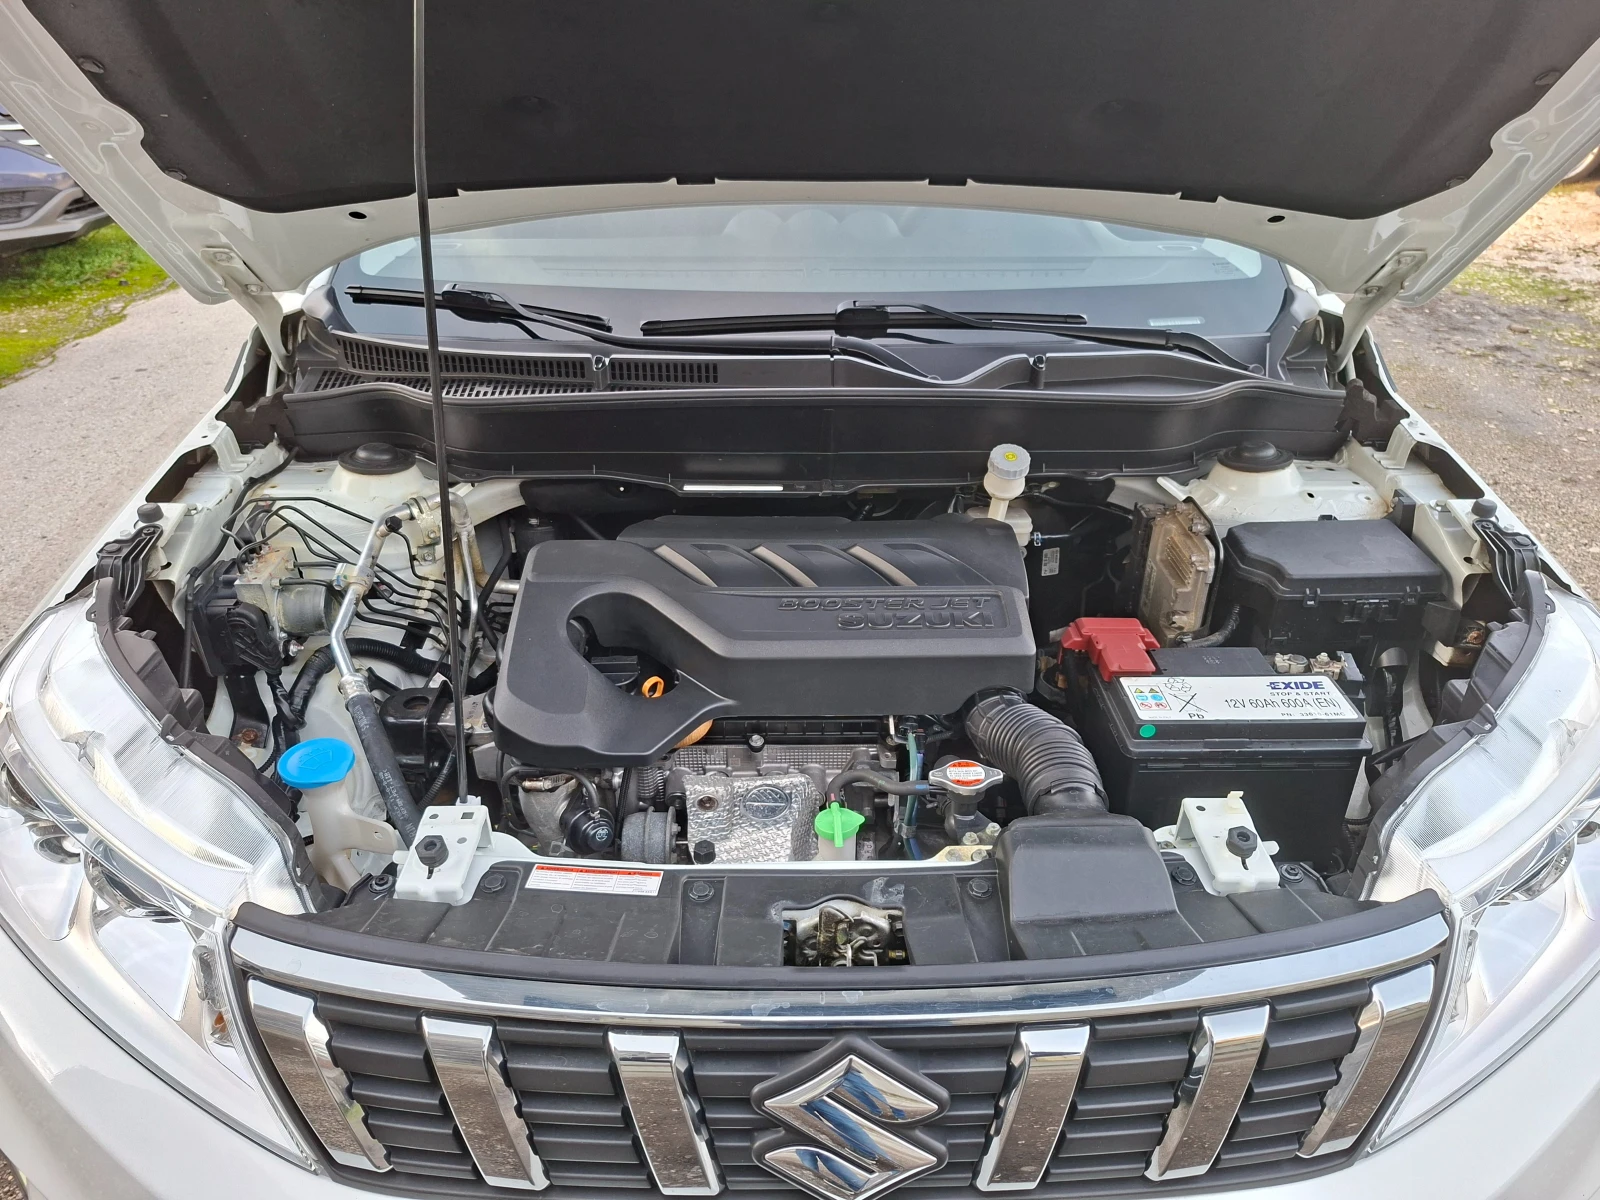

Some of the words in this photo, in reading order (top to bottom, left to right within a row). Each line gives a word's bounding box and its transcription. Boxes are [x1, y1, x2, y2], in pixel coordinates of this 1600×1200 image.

[777, 597, 925, 611] BOOSTER
[930, 596, 991, 609] JET
[837, 611, 995, 629] SUZUKI
[1266, 681, 1325, 690] EXIDE
[1225, 698, 1247, 709] 12V
[1249, 698, 1281, 710] 60Ah
[1281, 698, 1313, 709] 600A
[1313, 698, 1342, 710] (EN)
